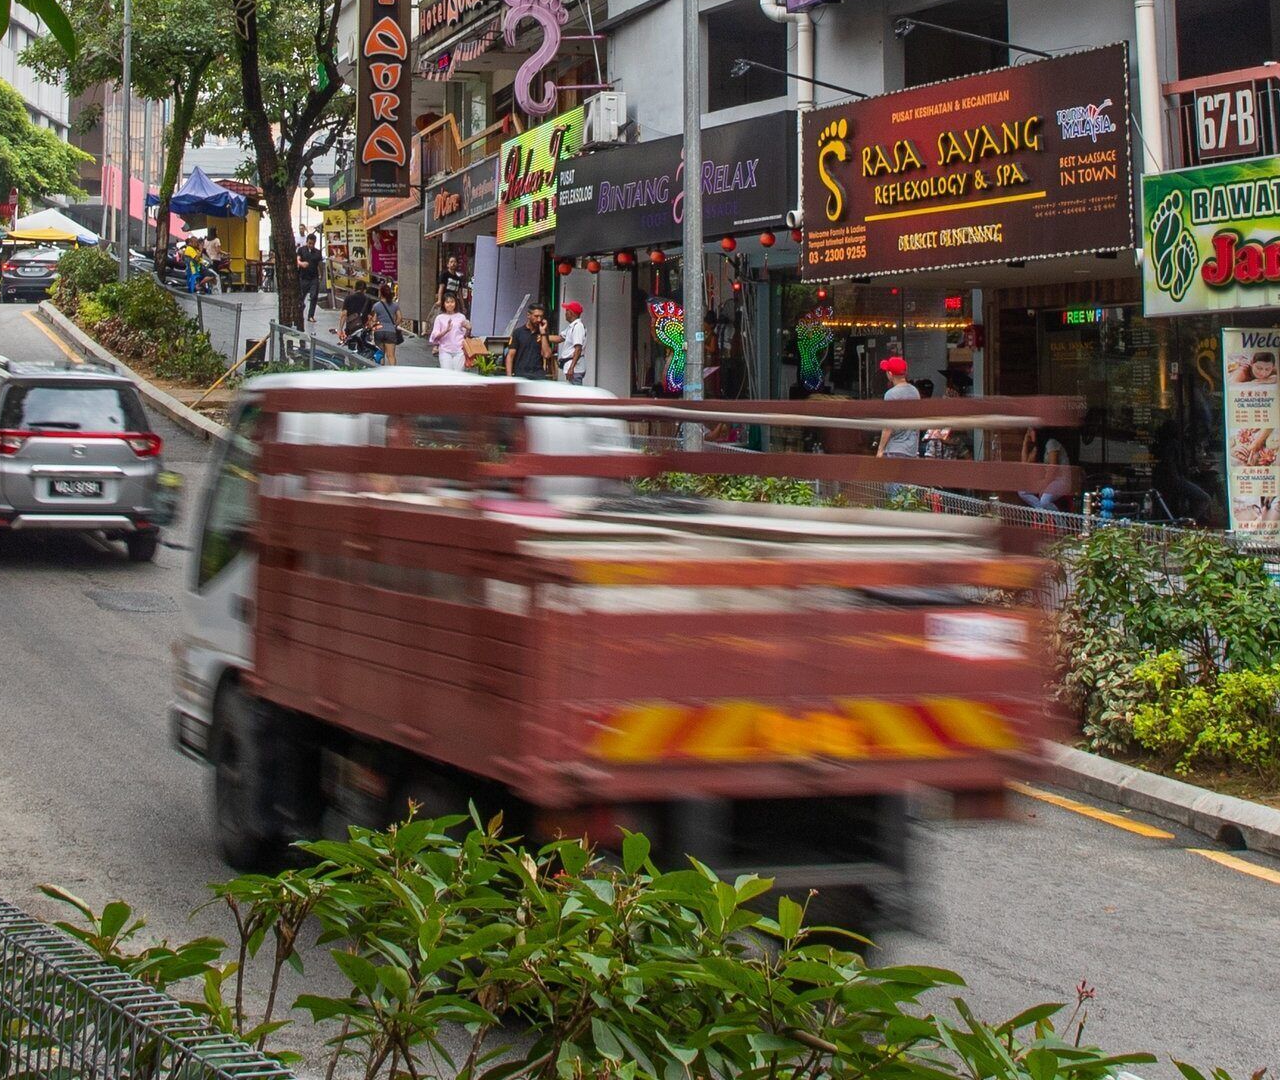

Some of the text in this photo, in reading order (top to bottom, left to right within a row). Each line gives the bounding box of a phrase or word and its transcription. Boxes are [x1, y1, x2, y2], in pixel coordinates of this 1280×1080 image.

[892, 90, 1010, 124] PUSAT KESIHATAN & KECANTIKAN
[1056, 106, 1089, 125] TOURISM
[1061, 114, 1112, 143] MALAYSIA
[1197, 89, 1256, 151] 67-B
[862, 116, 1040, 177] RASA SAYANG
[1059, 149, 1116, 168] BEST MASSAGE
[560, 169, 576, 186] PUSAT
[874, 163, 1025, 205] REFLEXOLOGY & SPA
[1060, 165, 1116, 186] IN TOWN
[559, 185, 593, 206] REFLEKSOLOGI
[597, 175, 671, 215] BINTANG
[701, 158, 760, 195] RELAX
[808, 229, 829, 239] Welcome
[830, 227, 845, 238] Family
[808, 251, 819, 264] 03
[825, 248, 845, 262] 2300
[846, 245, 867, 260] 9255
[944, 296, 962, 310] FREE
